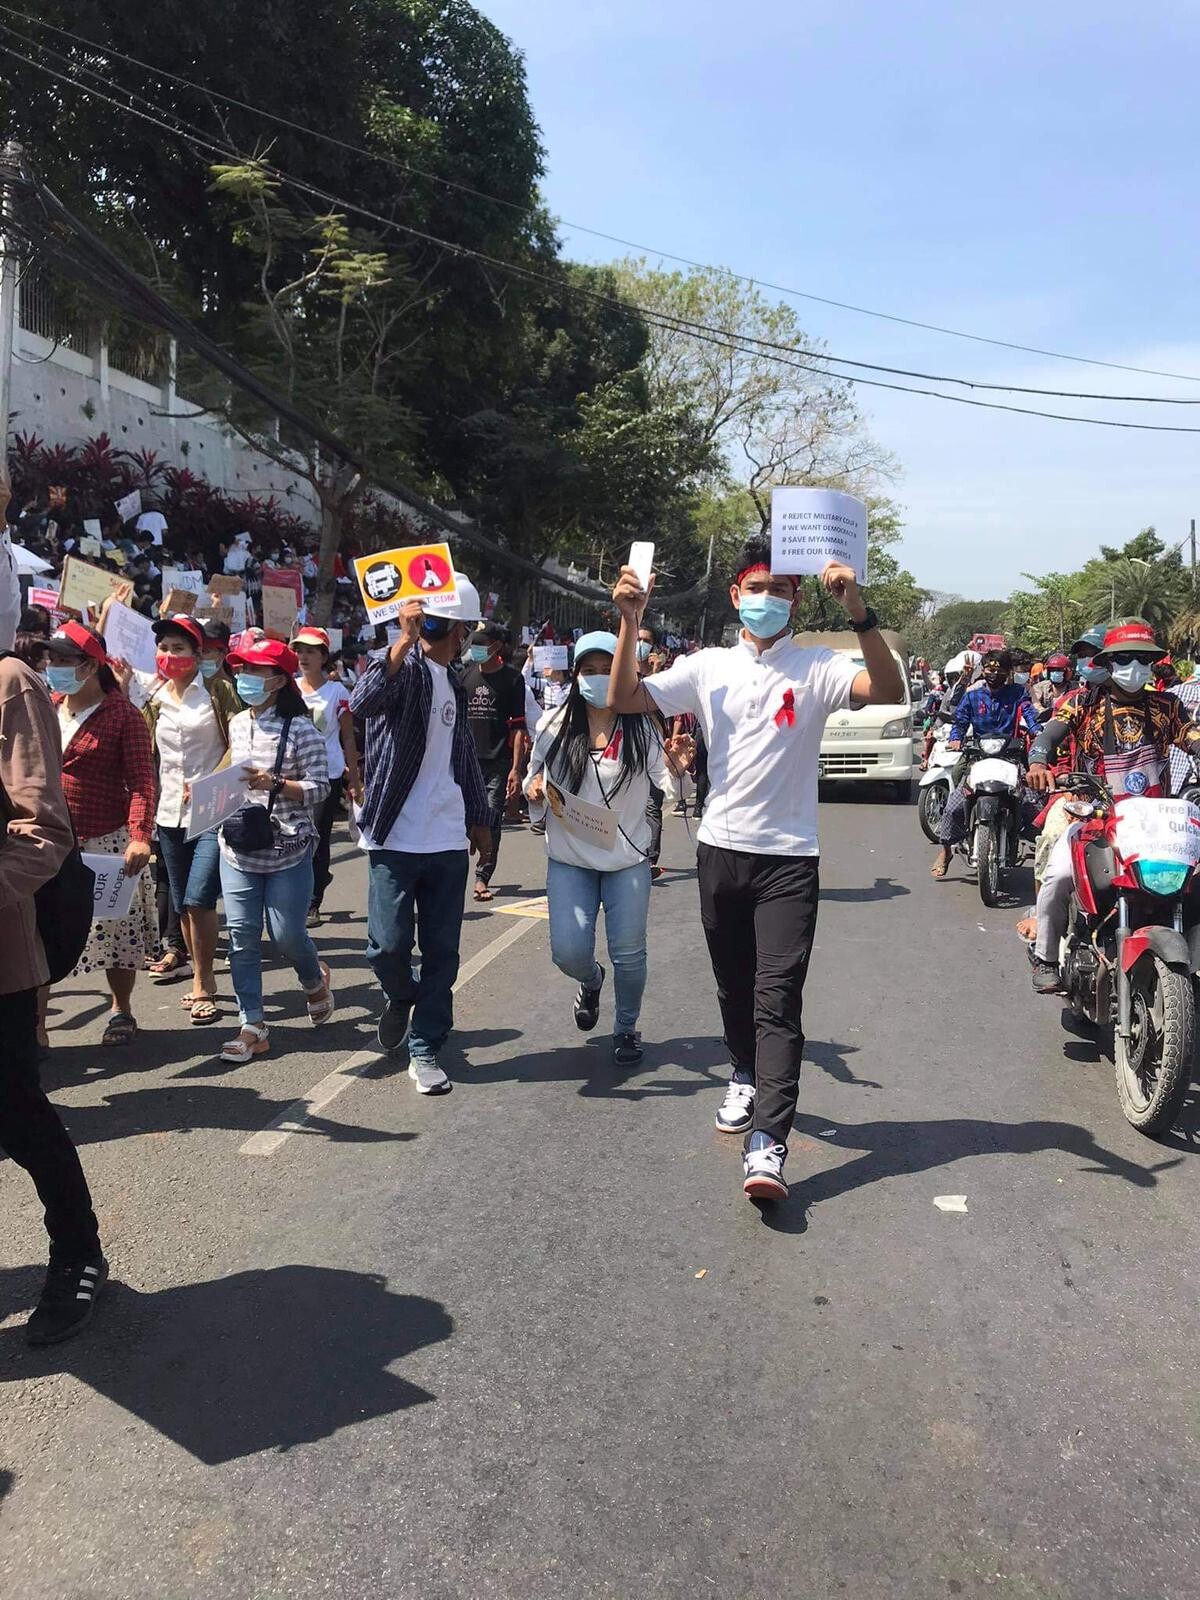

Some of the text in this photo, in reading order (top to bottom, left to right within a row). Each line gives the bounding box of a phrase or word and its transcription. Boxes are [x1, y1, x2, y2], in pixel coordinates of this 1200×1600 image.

[813, 513, 842, 522] MILITARY
[808, 536, 844, 545] MYANMAR
[372, 594, 455, 619] WE SUPT CDM
[1158, 803, 1185, 815] Free
[94, 873, 109, 901] OUR
